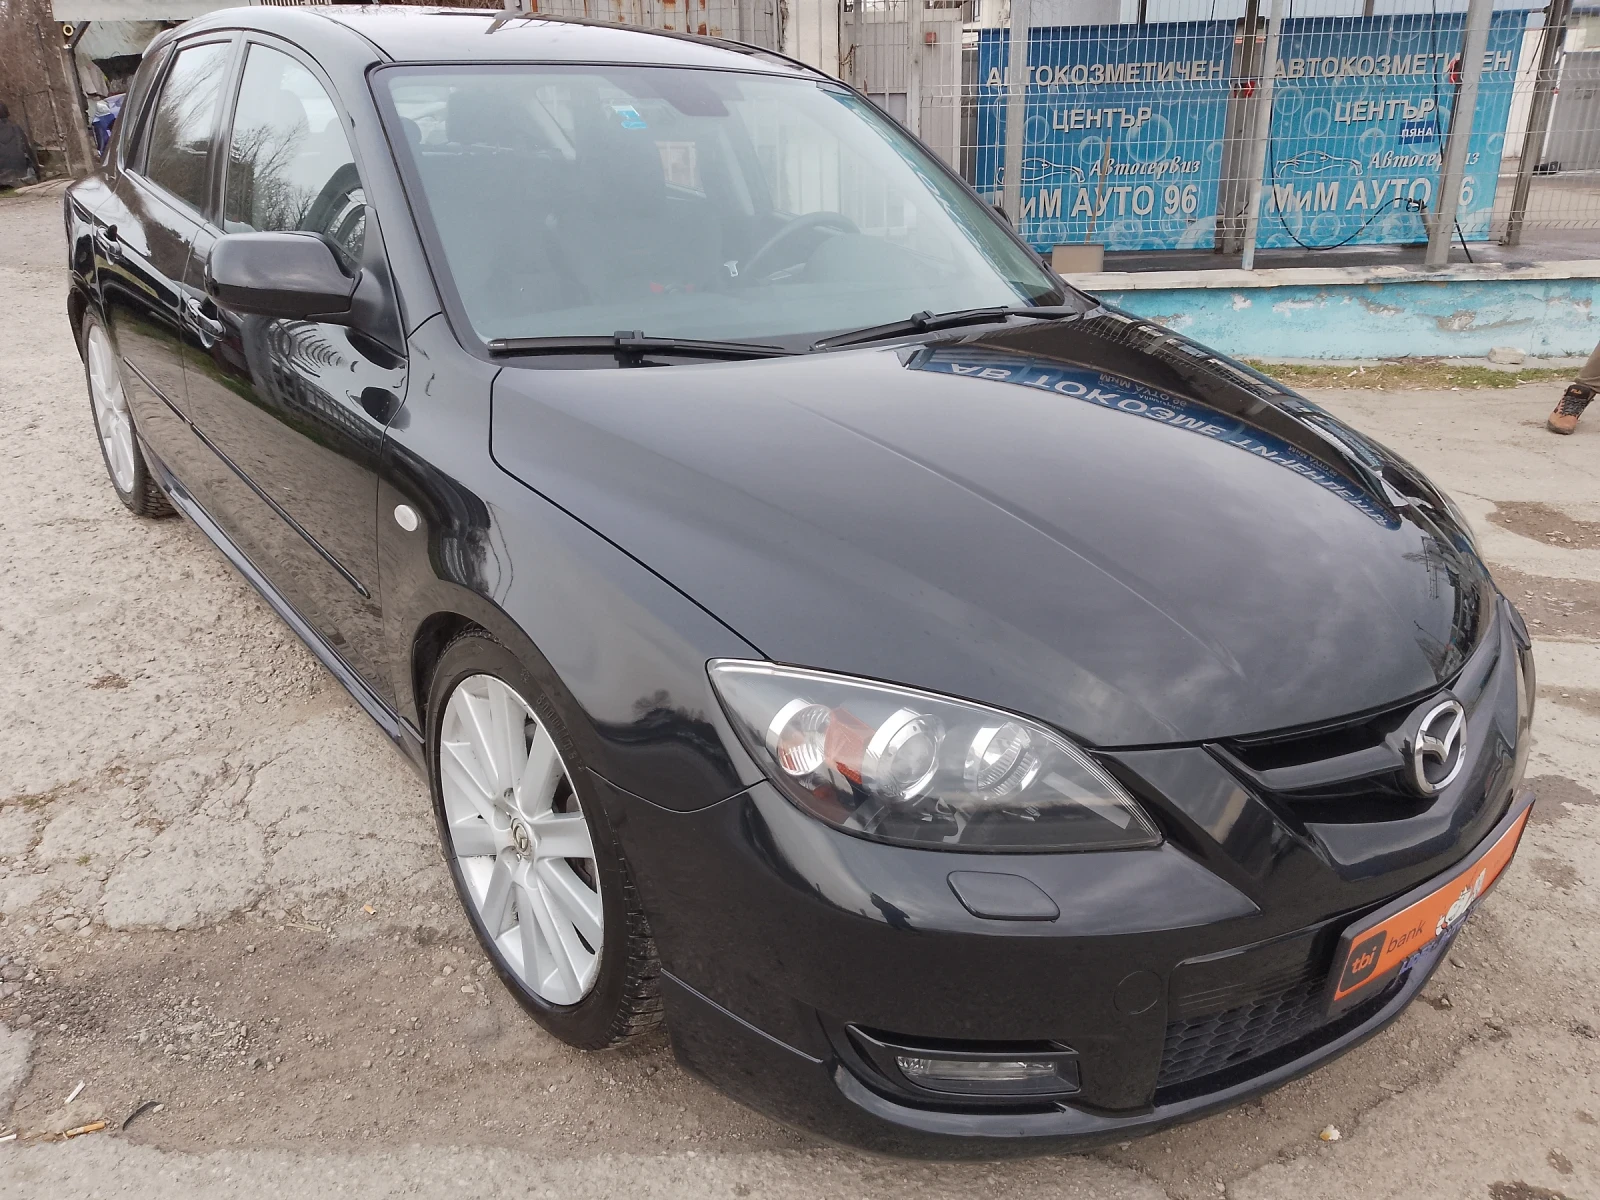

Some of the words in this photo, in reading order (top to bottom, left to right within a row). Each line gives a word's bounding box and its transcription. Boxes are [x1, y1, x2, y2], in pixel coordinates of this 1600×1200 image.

[1273, 50, 1512, 79] АВТОКОЗМЕТИЕН
[1053, 107, 1151, 133] ЦЕНТЪР
[1334, 98, 1435, 125] ЦЕНТЪР
[1401, 127, 1434, 138] ПЯНА
[1090, 156, 1201, 179] Автосервиз
[1367, 151, 1480, 172] Автосериз
[995, 188, 1062, 218] иМ
[1071, 186, 1155, 217] АУТО
[1163, 185, 1198, 214] 96
[1270, 182, 1339, 213] МиМ
[1345, 178, 1432, 210] АУТО
[1457, 176, 1475, 206] 6
[1351, 946, 1377, 974] tbi
[1386, 919, 1426, 954] bank
